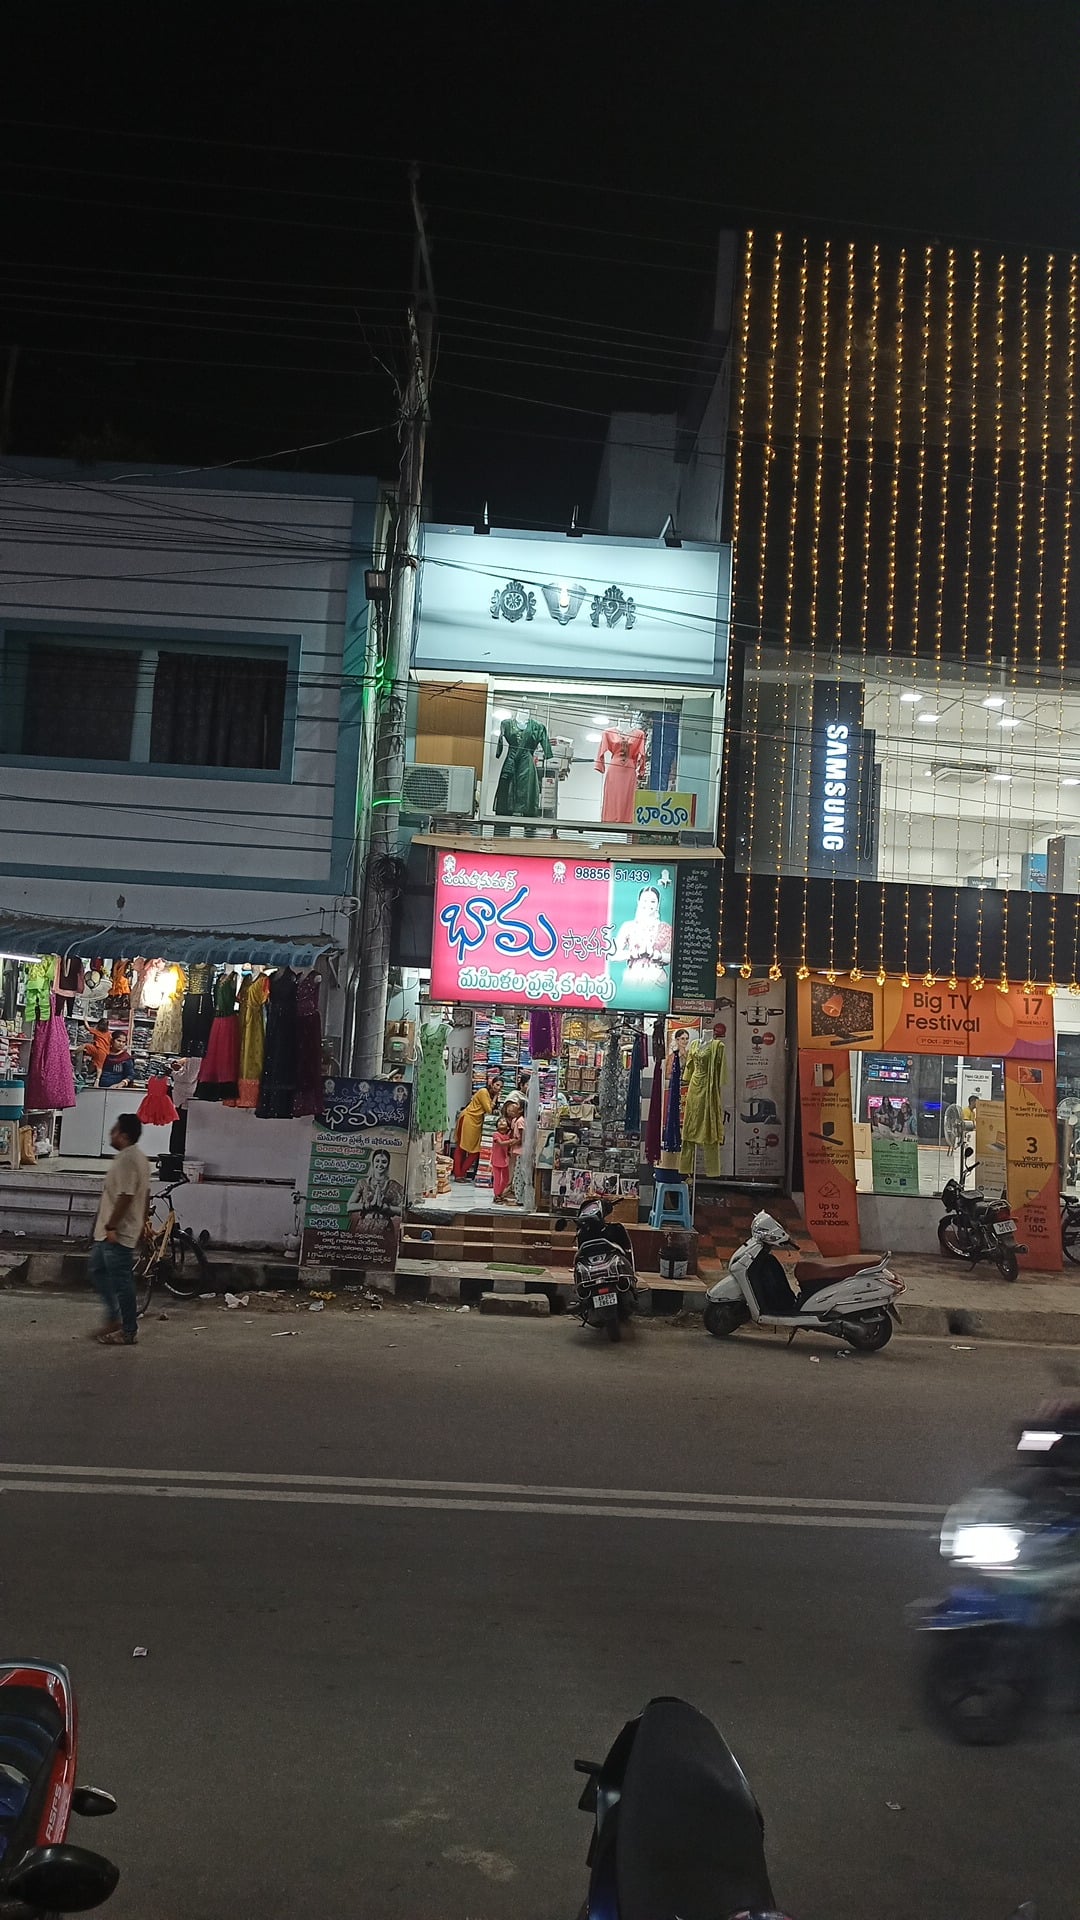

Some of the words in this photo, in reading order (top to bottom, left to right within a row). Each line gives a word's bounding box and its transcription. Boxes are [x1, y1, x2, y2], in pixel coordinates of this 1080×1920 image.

[822, 724, 849, 851] SAMSUNG
[574, 867, 610, 880] 98856
[614, 869, 651, 882] 51439
[440, 886, 559, 963] భామ
[458, 966, 526, 990] మహిళల
[526, 968, 576, 1001] ప్రత్యేక
[575, 973, 617, 1002] షాపు
[913, 992, 942, 1014] Big
[947, 993, 972, 1010] TV
[1023, 997, 1043, 1015] 17
[905, 1013, 981, 1034] Festival
[322, 1100, 378, 1130] భామ
[317, 1134, 348, 1143] మహిళల
[1026, 1136, 1038, 1154] 3
[1014, 1160, 1049, 1171] warranty
[818, 1203, 830, 1211] Up
[822, 1211, 839, 1219] 20%
[809, 1219, 850, 1227] cashback
[1024, 1215, 1046, 1224] Free
